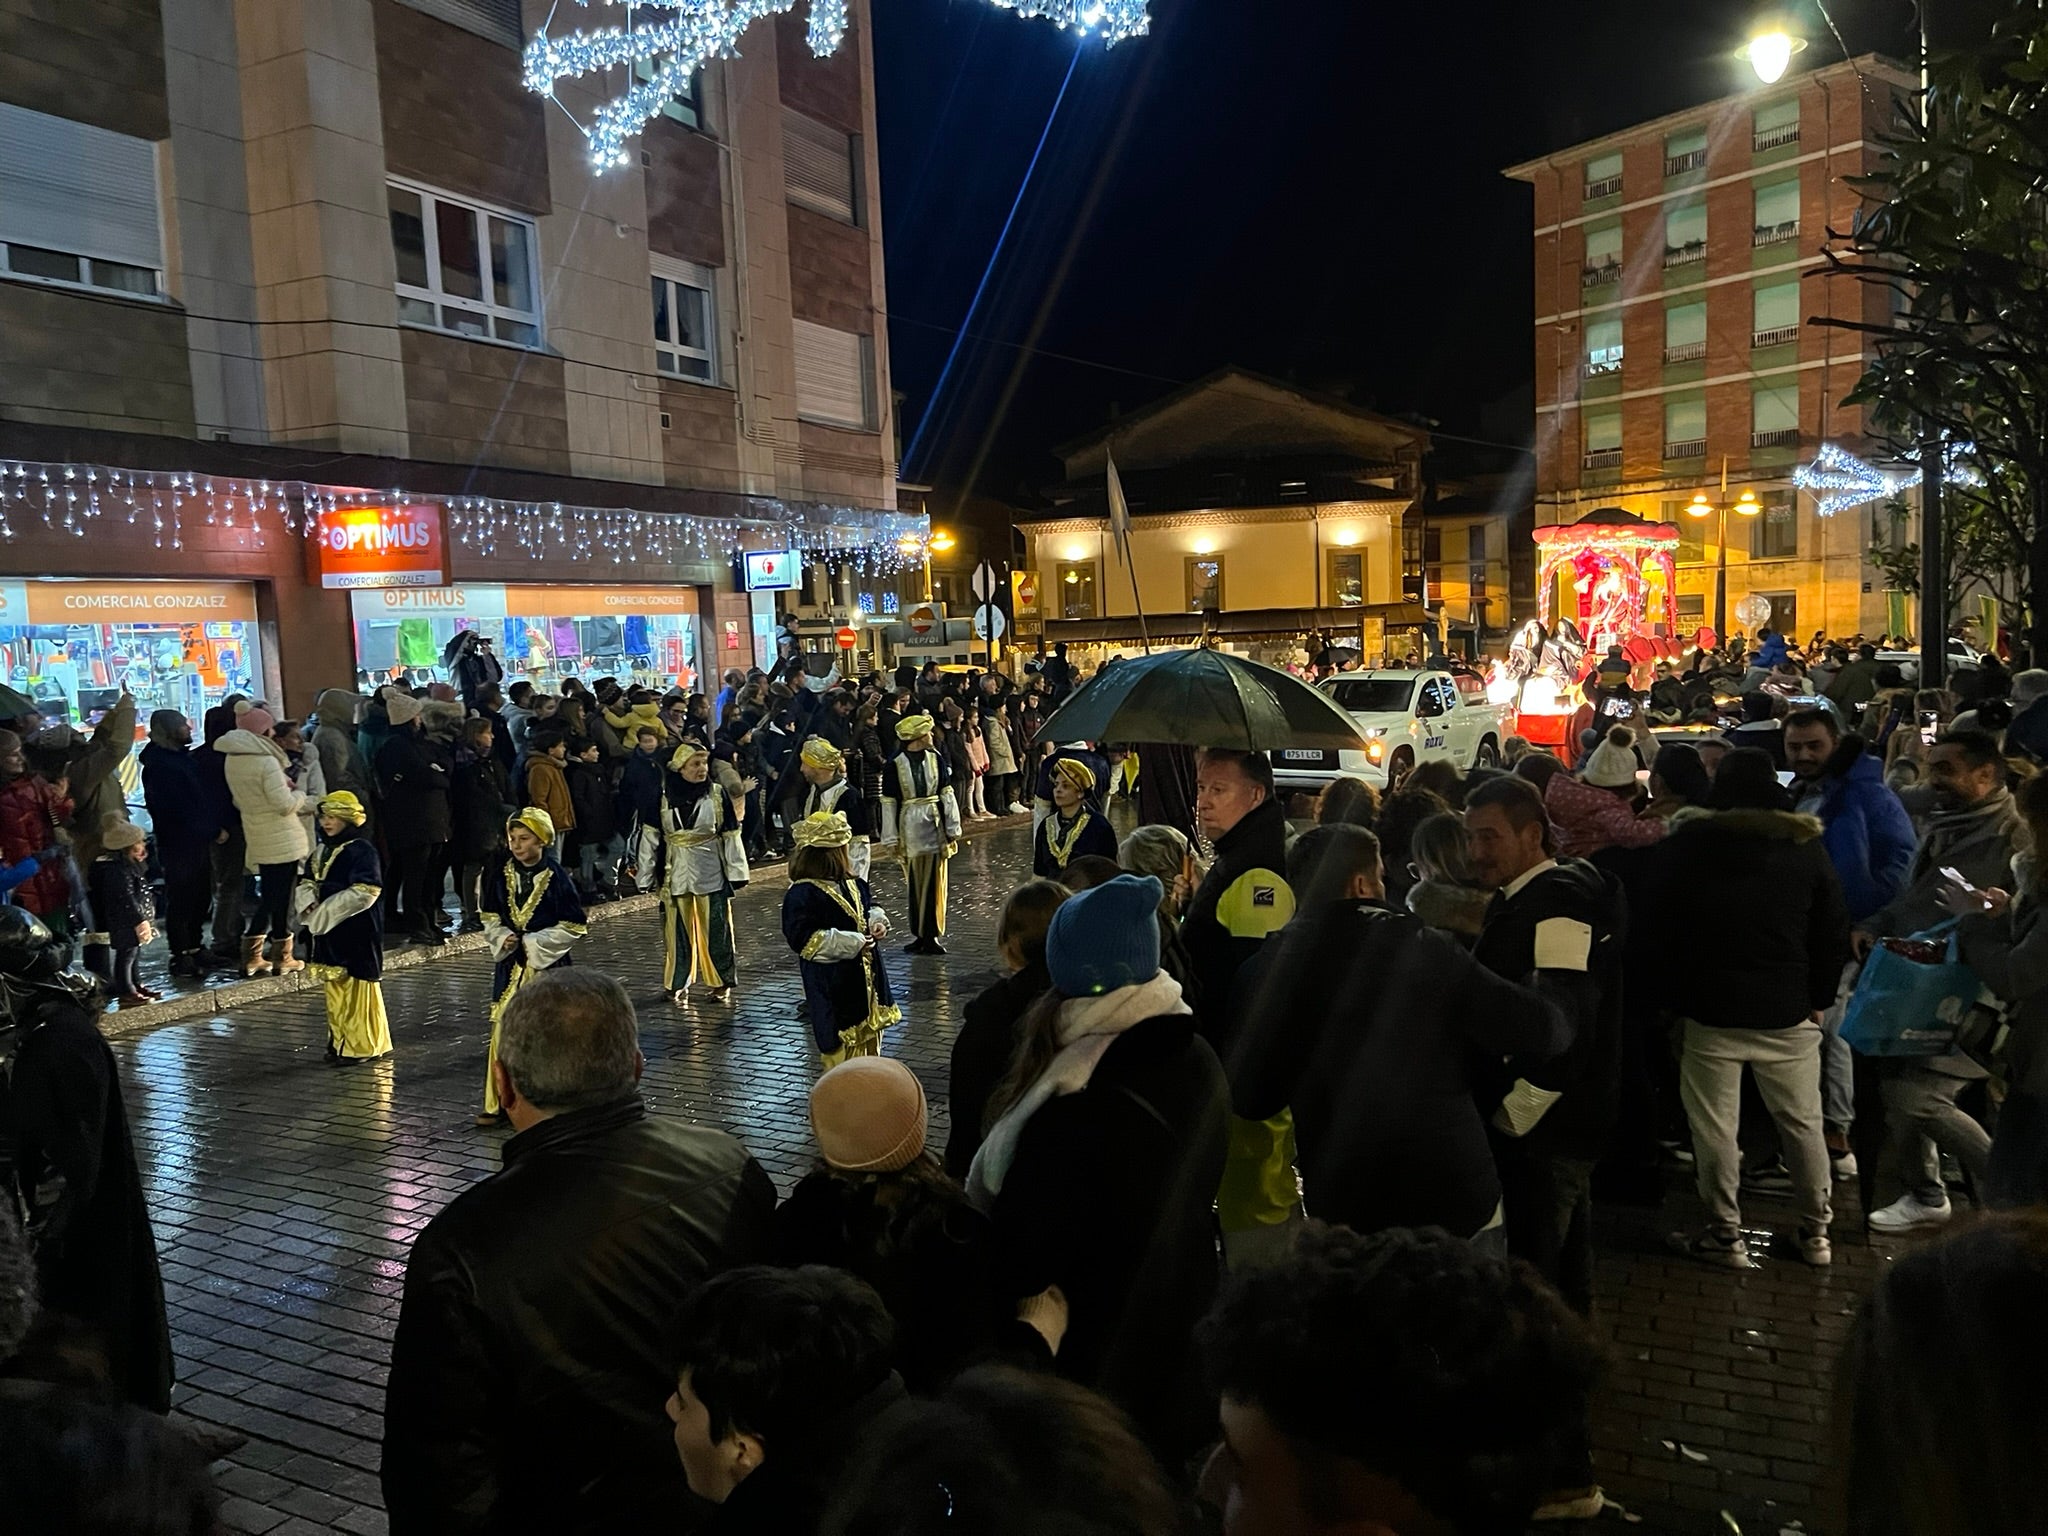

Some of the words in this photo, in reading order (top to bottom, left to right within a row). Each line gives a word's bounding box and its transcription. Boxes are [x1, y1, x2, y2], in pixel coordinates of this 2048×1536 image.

[330, 522, 430, 550] OPTIMUS
[338, 575, 383, 587] COMERCIAL
[384, 574, 425, 585] GONZALEZ
[64, 595, 151, 609] COMERCIAL
[153, 595, 228, 608] GONZALEZ
[384, 589, 465, 606] OPTIMUS
[605, 595, 647, 605] COMERCIAL
[648, 595, 684, 605] GONZALEZ
[908, 636, 939, 644] REPSOL
